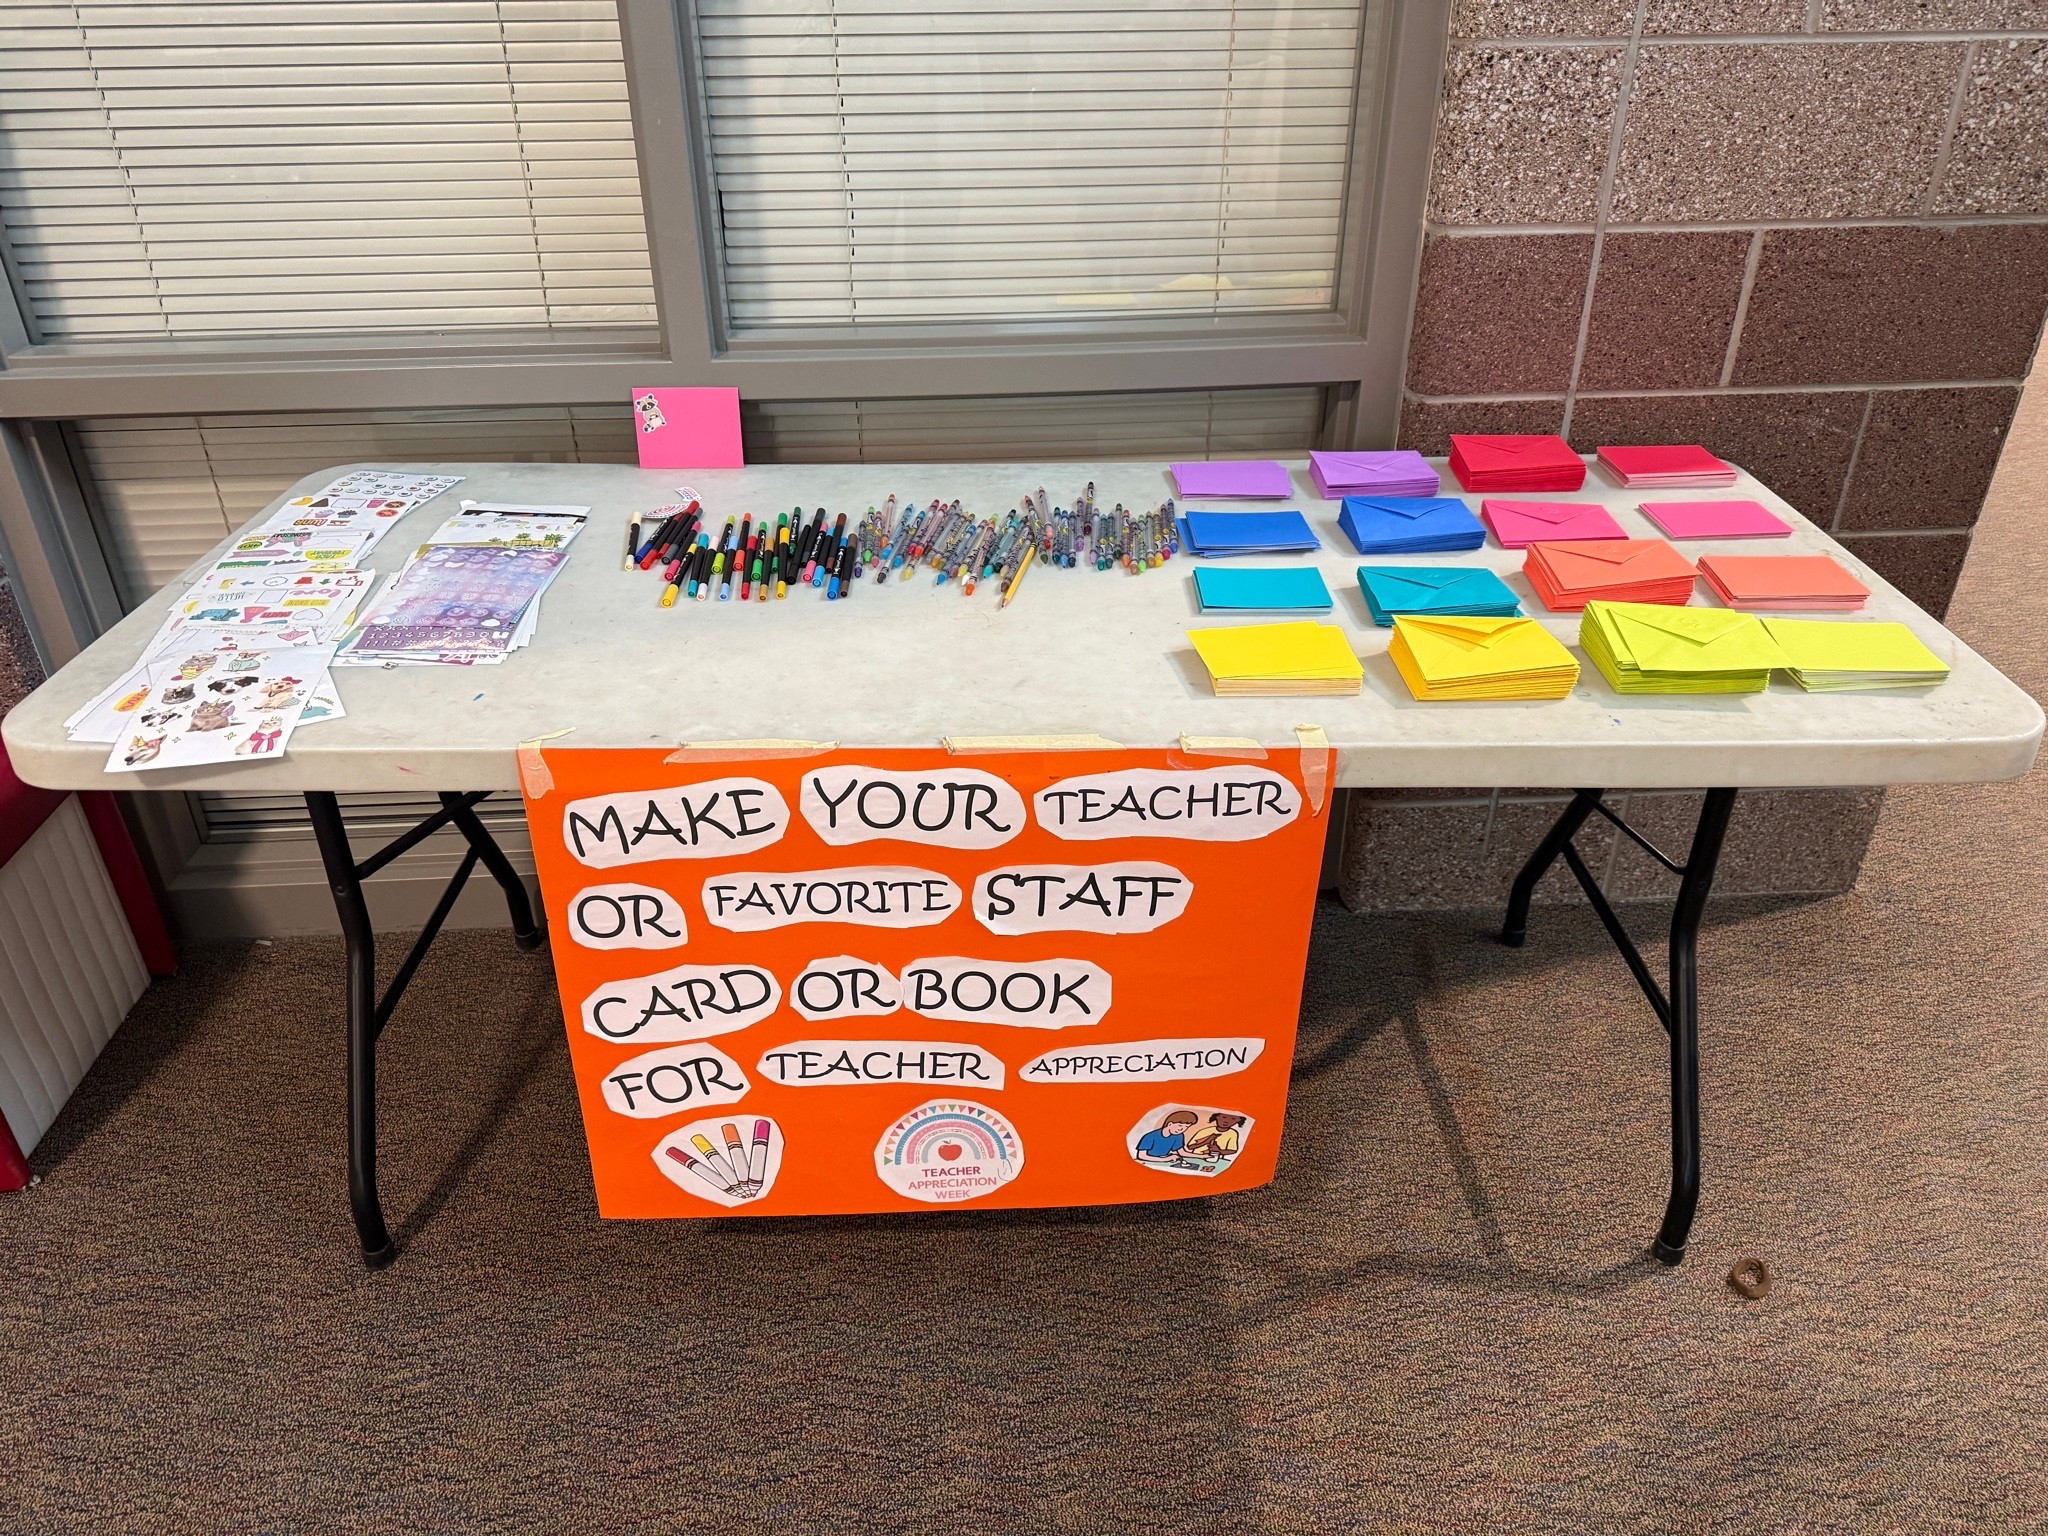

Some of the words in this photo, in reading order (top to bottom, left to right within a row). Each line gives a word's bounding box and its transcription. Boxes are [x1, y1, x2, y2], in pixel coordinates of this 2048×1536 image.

[570, 789, 776, 858] MAKE
[813, 777, 1011, 832] YOUR
[1043, 780, 1292, 825] TEACHER
[576, 894, 681, 939] OR
[709, 880, 952, 917] FAVORITE
[986, 872, 1182, 921] STAFF
[593, 969, 771, 1038] CARD
[797, 968, 896, 1012] OR
[908, 968, 1091, 1015] BOOK
[609, 1057, 744, 1110] FOR
[765, 1050, 990, 1081] TEACHER
[1029, 1046, 1247, 1076] APPRECIATION
[908, 1177, 997, 1190] APPRECIATION
[922, 1166, 981, 1177] TEACHER
[935, 1189, 970, 1199] WEEK
